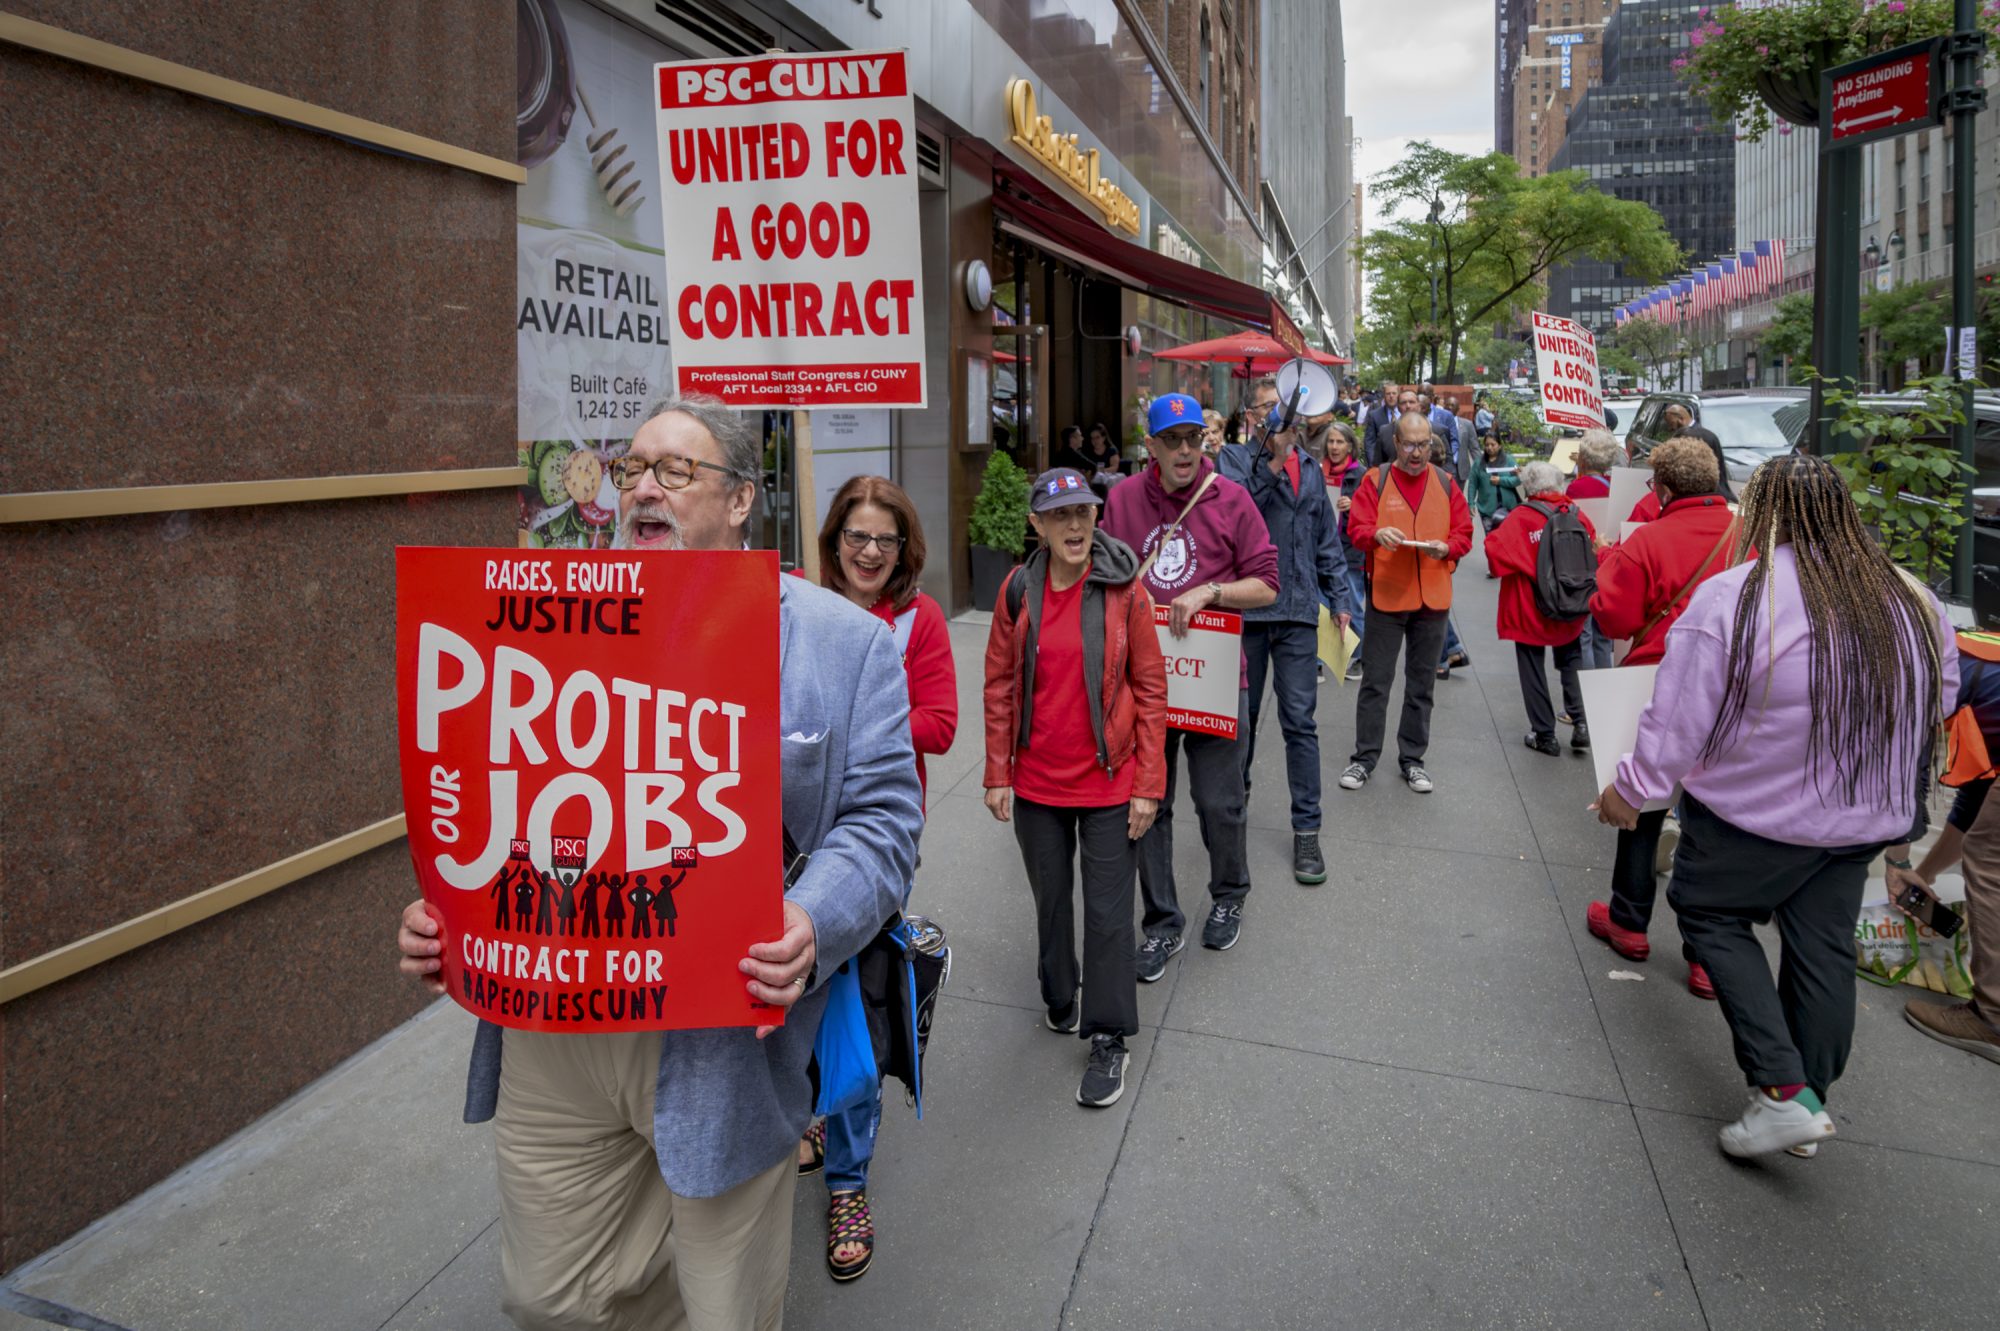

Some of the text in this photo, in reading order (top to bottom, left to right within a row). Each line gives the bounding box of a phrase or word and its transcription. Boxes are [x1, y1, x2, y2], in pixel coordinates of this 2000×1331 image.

[1546, 33, 1583, 45] HOTEL
[677, 58, 888, 104] PSC-CUNY
[1837, 61, 1913, 94] NO STANDING
[1837, 87, 1884, 109] Anytime
[669, 118, 907, 185] UNITED FOR
[712, 201, 870, 261] A GOOD
[555, 258, 659, 307] RETAIL
[517, 297, 669, 346] AVAILABL
[678, 279, 914, 340] CONTRACT
[1539, 315, 1590, 343] PSC-CUNY
[1538, 332, 1597, 368] UNITED FOR
[571, 374, 647, 396] Built Café
[691, 371, 768, 382] Professional
[771, 370, 795, 381] Staff
[798, 369, 861, 382] Congress
[871, 369, 907, 379] CUNY
[722, 382, 877, 394] AFT Local 2334 AFL CIO
[1554, 360, 1593, 387] A GOOD
[577, 400, 642, 422] 1,242 SF
[1544, 382, 1603, 416] CONTRACT
[485, 560, 645, 597] RAISES, EQUITY,
[485, 596, 642, 636] JUSTICE
[1194, 613, 1226, 628] Want
[1164, 655, 1205, 679] ECT
[416, 622, 747, 772] PROTECT
[1166, 712, 1235, 733] eoplesCUNY
[429, 764, 462, 843] OUR
[434, 769, 747, 891] JOBS
[511, 839, 529, 853] PSC
[553, 838, 586, 857] PSC
[555, 856, 583, 867] CUNY
[673, 848, 695, 860] PSC
[462, 933, 663, 983] CONTRACT FOR
[462, 968, 668, 1022] #APEOPLESCUNY
